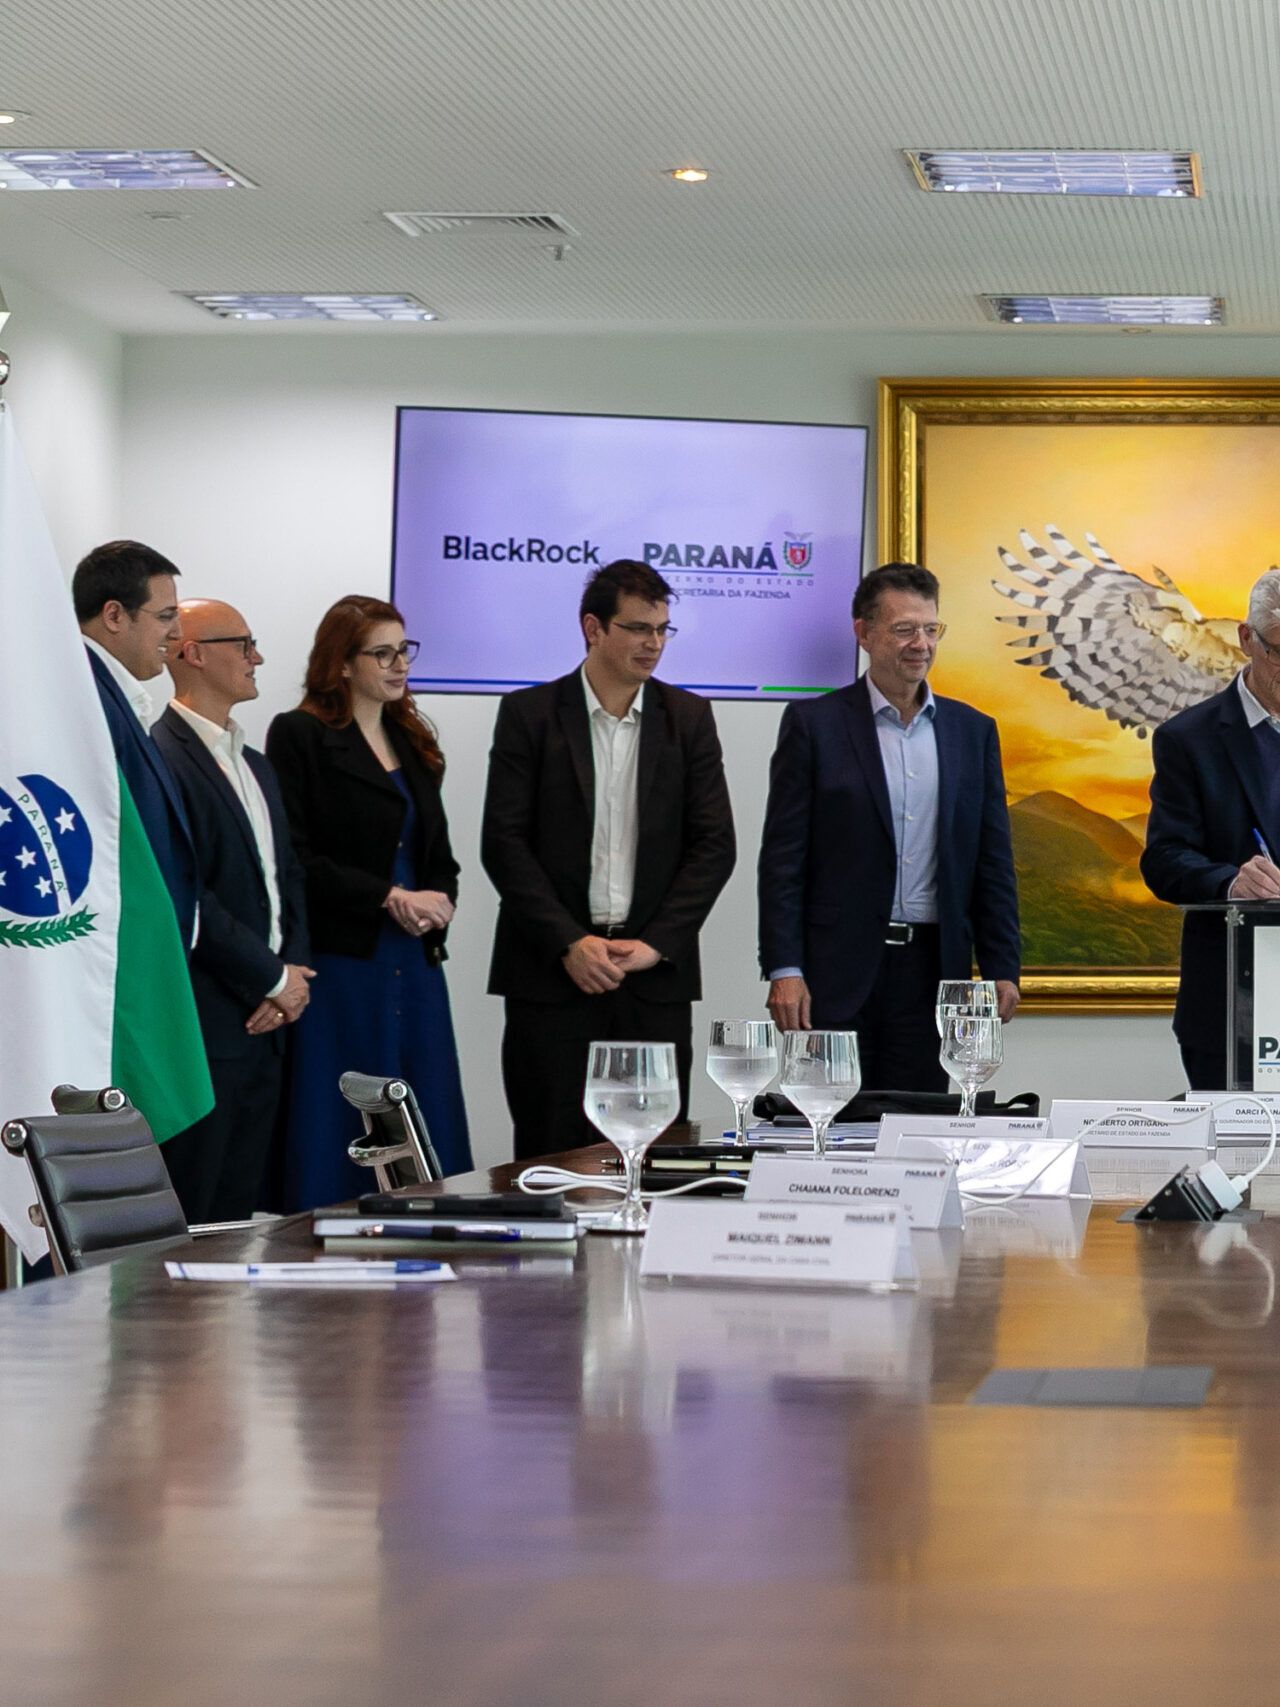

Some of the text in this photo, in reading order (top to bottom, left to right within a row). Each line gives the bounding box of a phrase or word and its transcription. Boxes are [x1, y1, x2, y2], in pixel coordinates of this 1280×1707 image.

[443, 535, 600, 564] BlackRock
[643, 542, 778, 570] PARANÁ
[726, 577, 744, 585] DO
[757, 578, 814, 586] ESTADO
[727, 589, 742, 599] DA
[744, 589, 791, 600] FAZENDA
[17, 793, 68, 892] PARANÁ
[1083, 1119, 1126, 1127] NOBERTO
